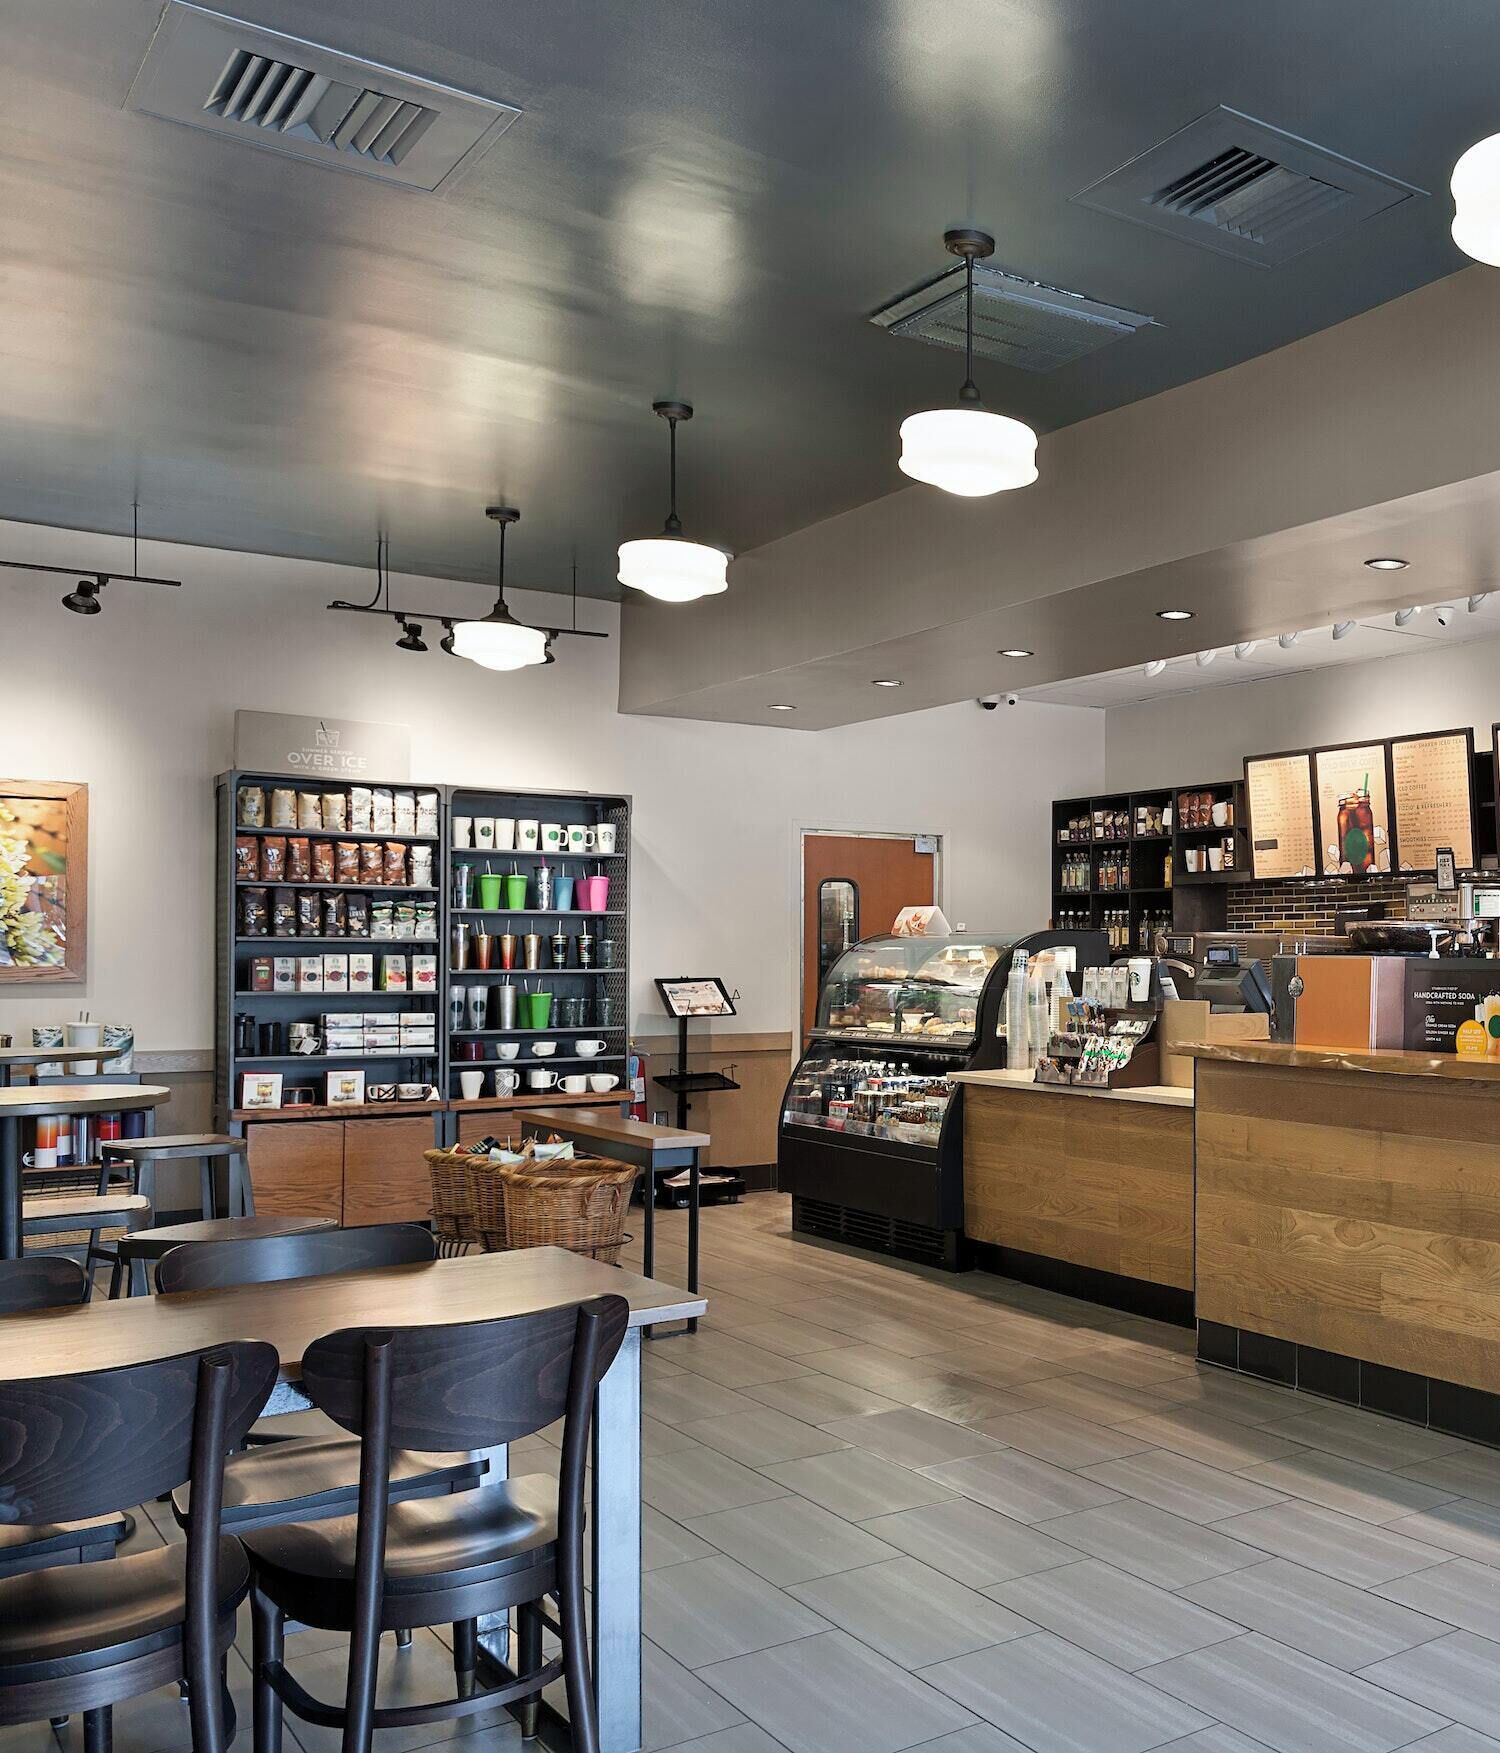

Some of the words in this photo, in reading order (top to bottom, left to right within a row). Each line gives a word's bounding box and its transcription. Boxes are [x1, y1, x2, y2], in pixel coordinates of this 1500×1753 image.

[287, 752, 334, 766] OVER
[341, 756, 368, 769] ICE
[1414, 991, 1457, 1000] HANDCRAFTED
[1458, 992, 1476, 1000] SODA
